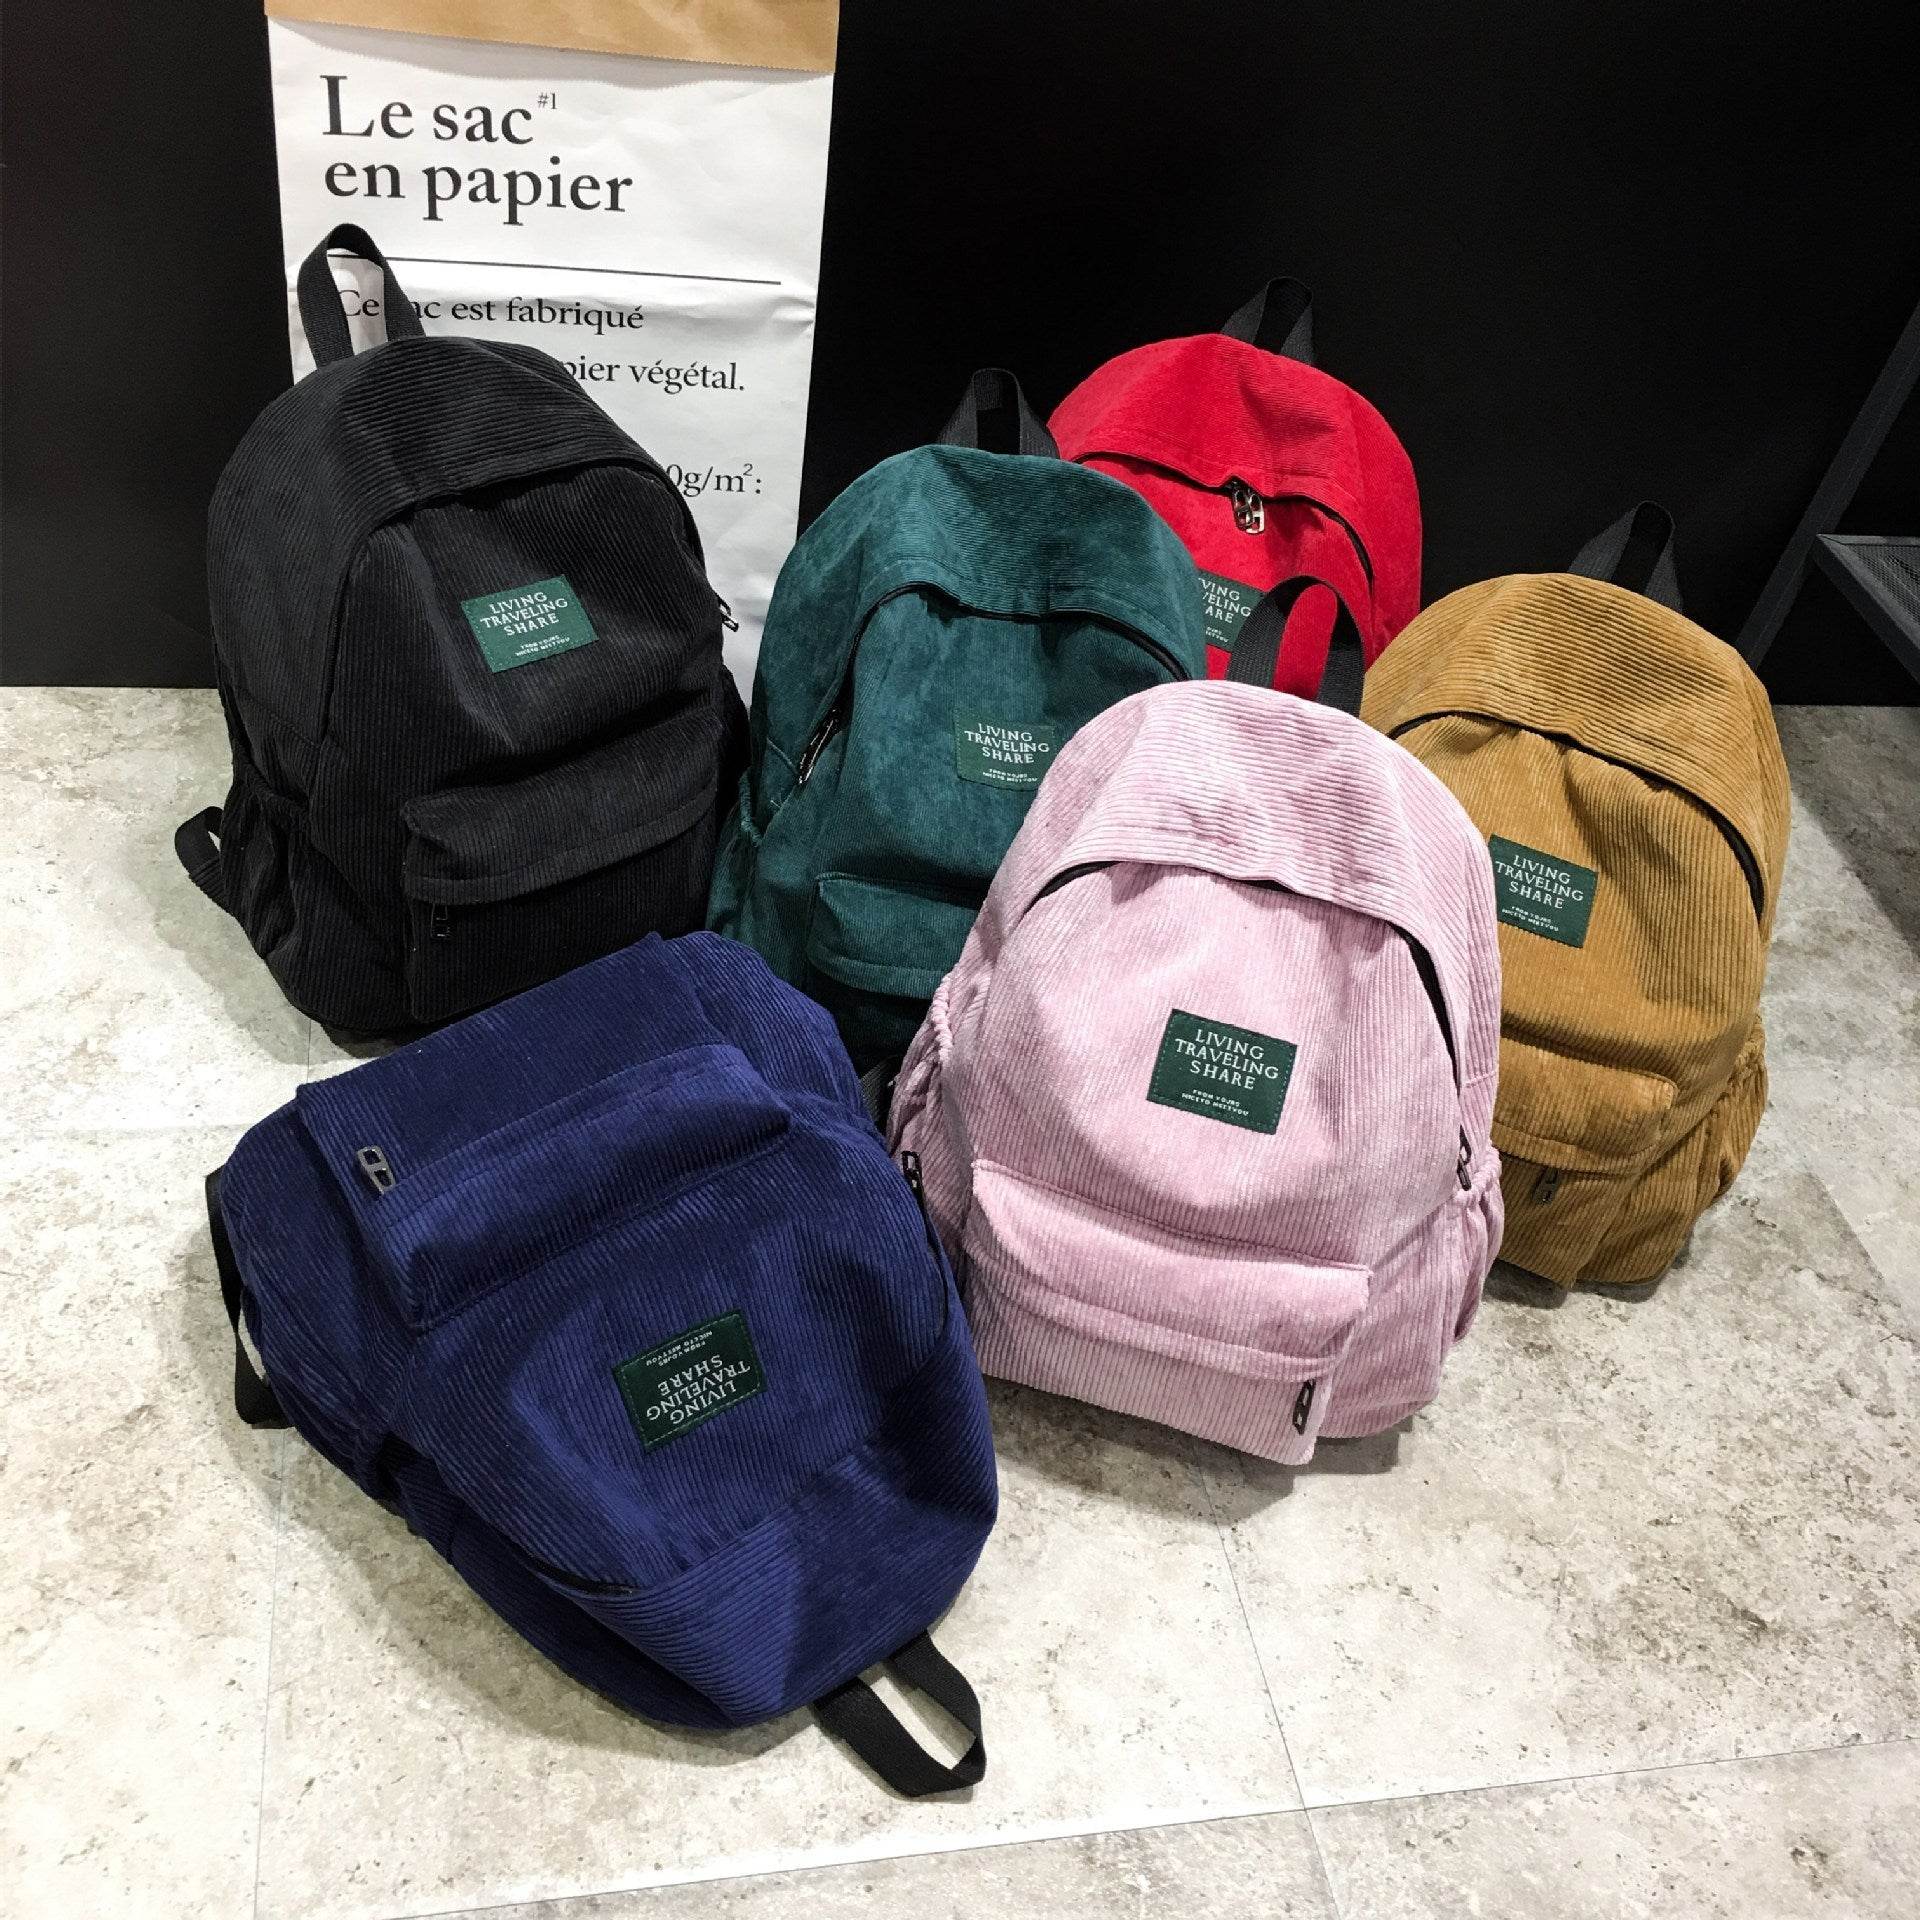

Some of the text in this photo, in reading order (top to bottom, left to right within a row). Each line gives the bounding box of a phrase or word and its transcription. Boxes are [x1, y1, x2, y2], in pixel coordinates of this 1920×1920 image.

[320, 75, 557, 145] Le sac #1
[325, 155, 633, 226] en papier
[339, 289, 380, 317] Ce
[451, 300, 497, 321] est
[506, 296, 644, 336] fabriqué
[628, 359, 744, 395] végétal.
[480, 598, 568, 628] TRAVELING
[489, 592, 547, 614] LIVING
[504, 613, 559, 636] SHARE
[964, 731, 1050, 752] TRAVELING
[978, 723, 1033, 741] LIVING
[982, 746, 1034, 764] SHARE
[1495, 860, 1584, 901] TRAVELING
[1513, 854, 1571, 884] LIVING
[1508, 881, 1565, 909] SHARE
[1175, 1038, 1279, 1080] TRAVELING
[1195, 1029, 1265, 1060] LIVING
[1190, 1060, 1256, 1090] SHARE
[646, 1360, 750, 1420] TRAVELING
[658, 1354, 723, 1397] SHARE
[670, 1380, 737, 1424] LIVING
